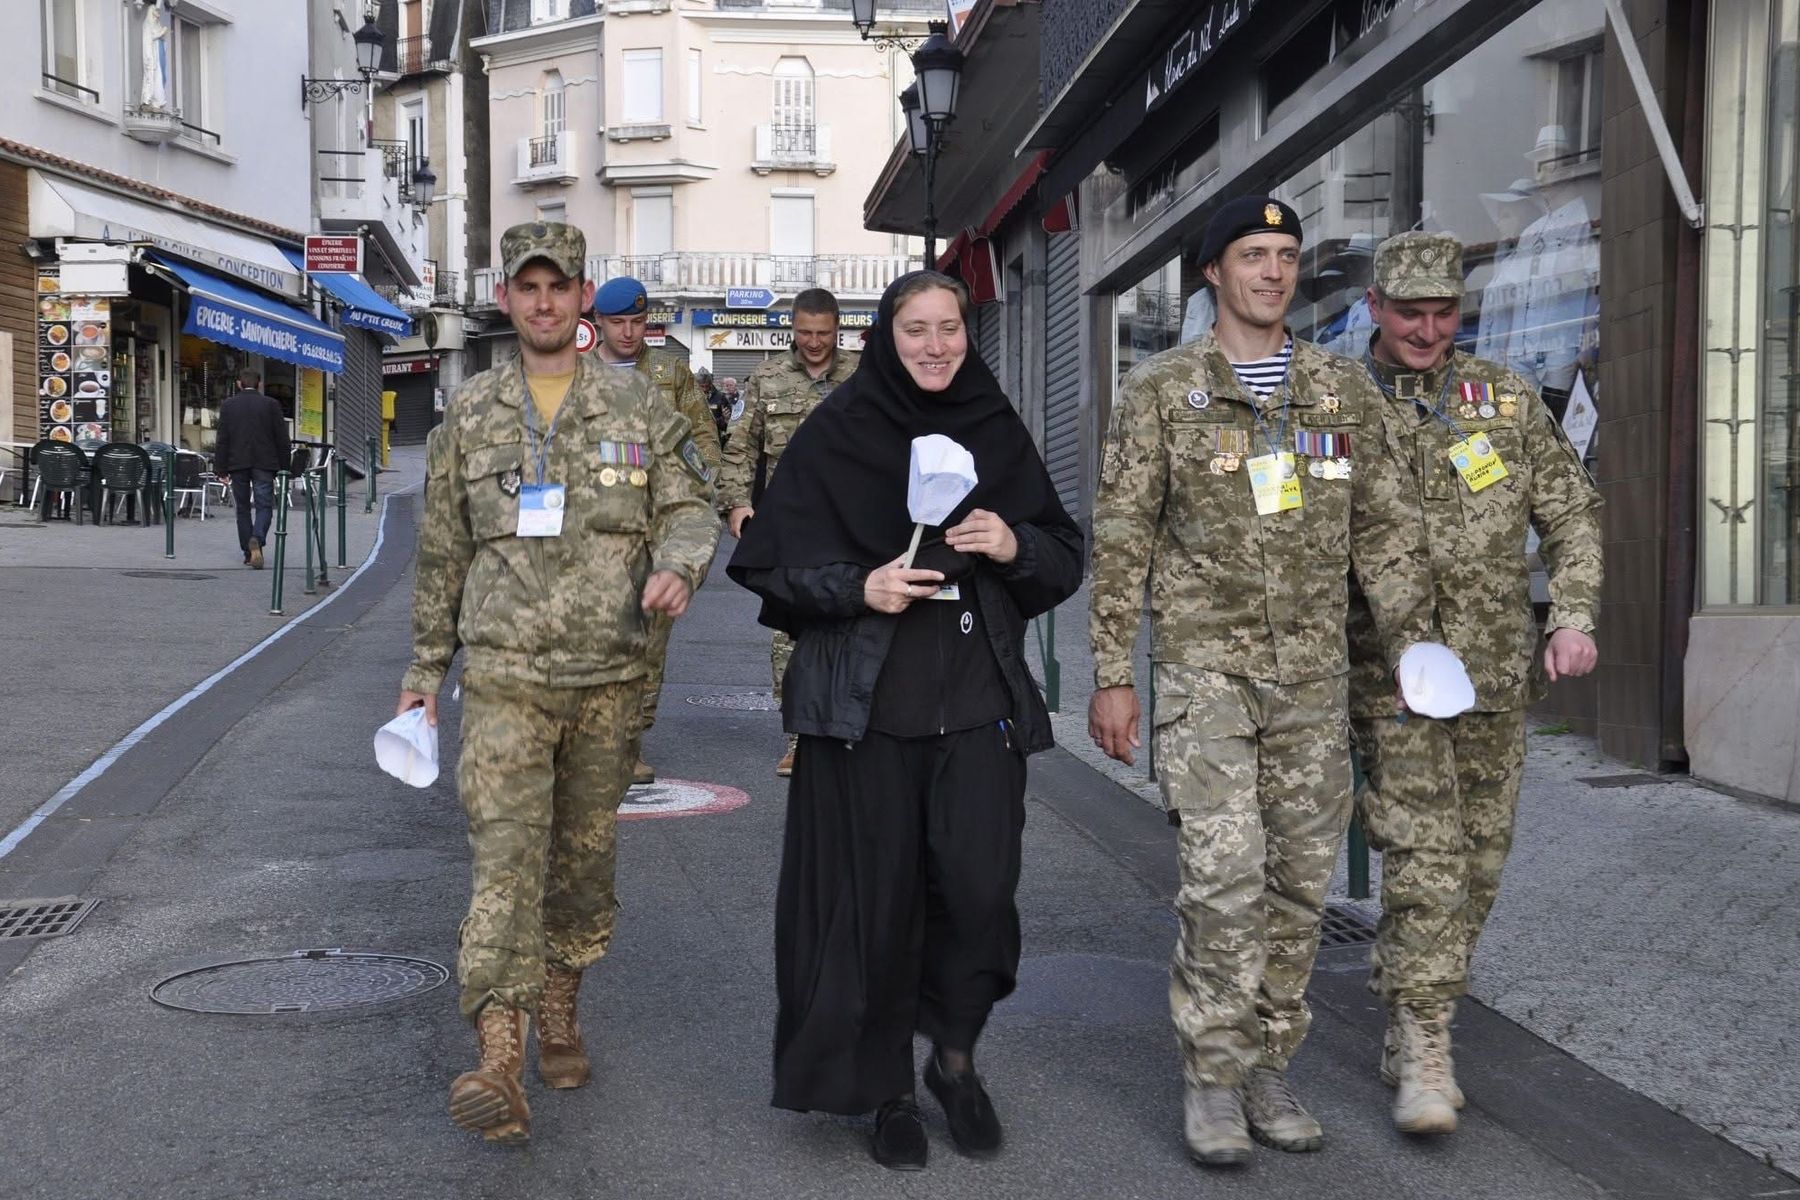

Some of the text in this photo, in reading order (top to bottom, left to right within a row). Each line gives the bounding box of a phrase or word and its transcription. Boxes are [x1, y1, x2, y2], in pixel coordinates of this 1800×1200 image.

[218, 257, 284, 290] CONCEPTION
[729, 290, 764, 299] PARKING
[350, 310, 361, 321] AU
[712, 313, 767, 325] CONFISERIE
[839, 313, 873, 326] UEURS
[196, 306, 235, 335] EPICERIE
[240, 318, 298, 353] SANDWICHERIE
[737, 332, 764, 346] PAIN
